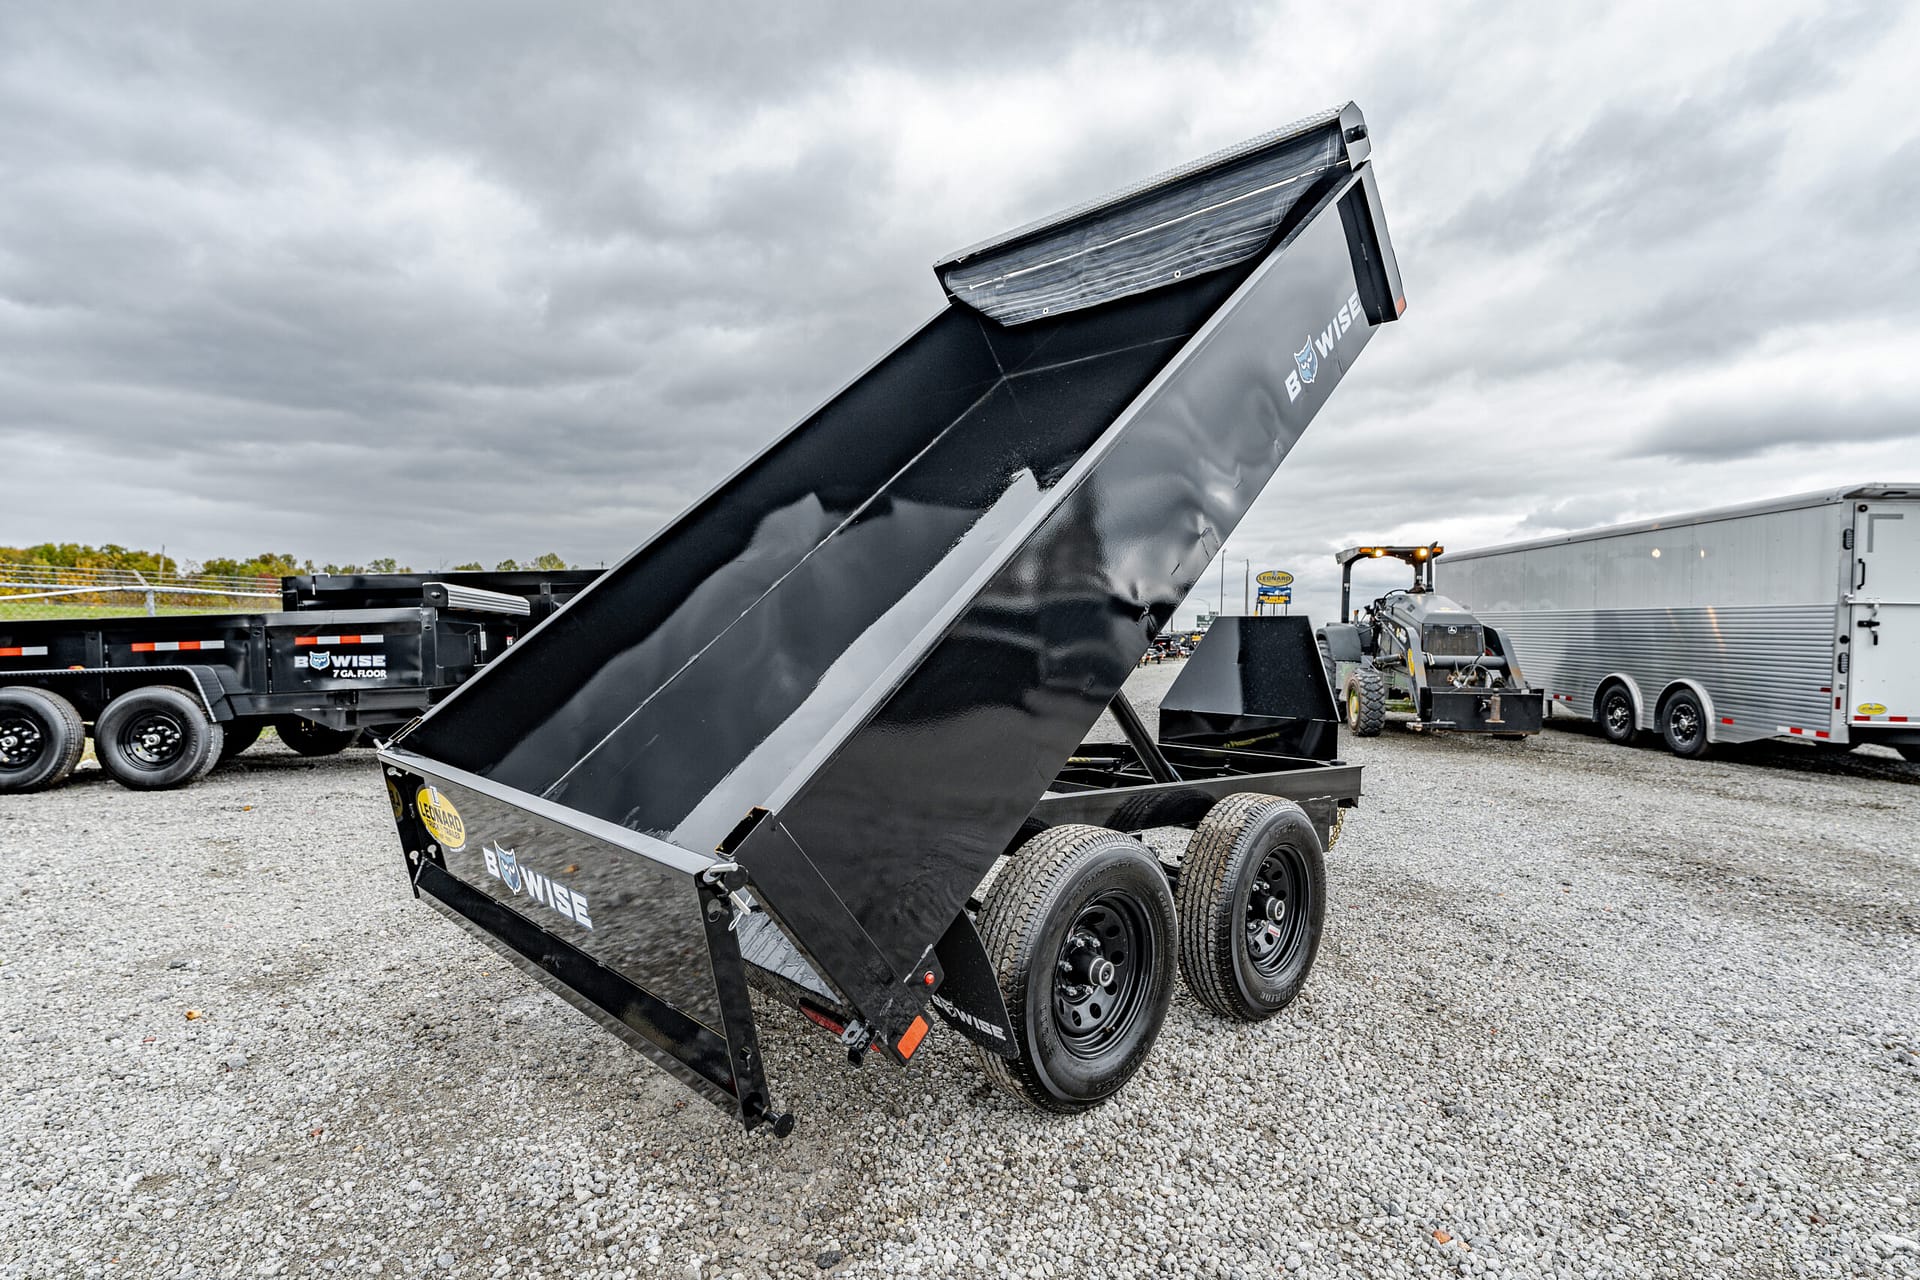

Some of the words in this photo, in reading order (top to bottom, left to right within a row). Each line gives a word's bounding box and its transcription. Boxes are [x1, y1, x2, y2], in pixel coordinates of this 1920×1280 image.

[333, 669, 338, 678] 7
[340, 669, 357, 678] GA.
[358, 669, 387, 678] FLOOR
[418, 800, 462, 833] LEONARD
